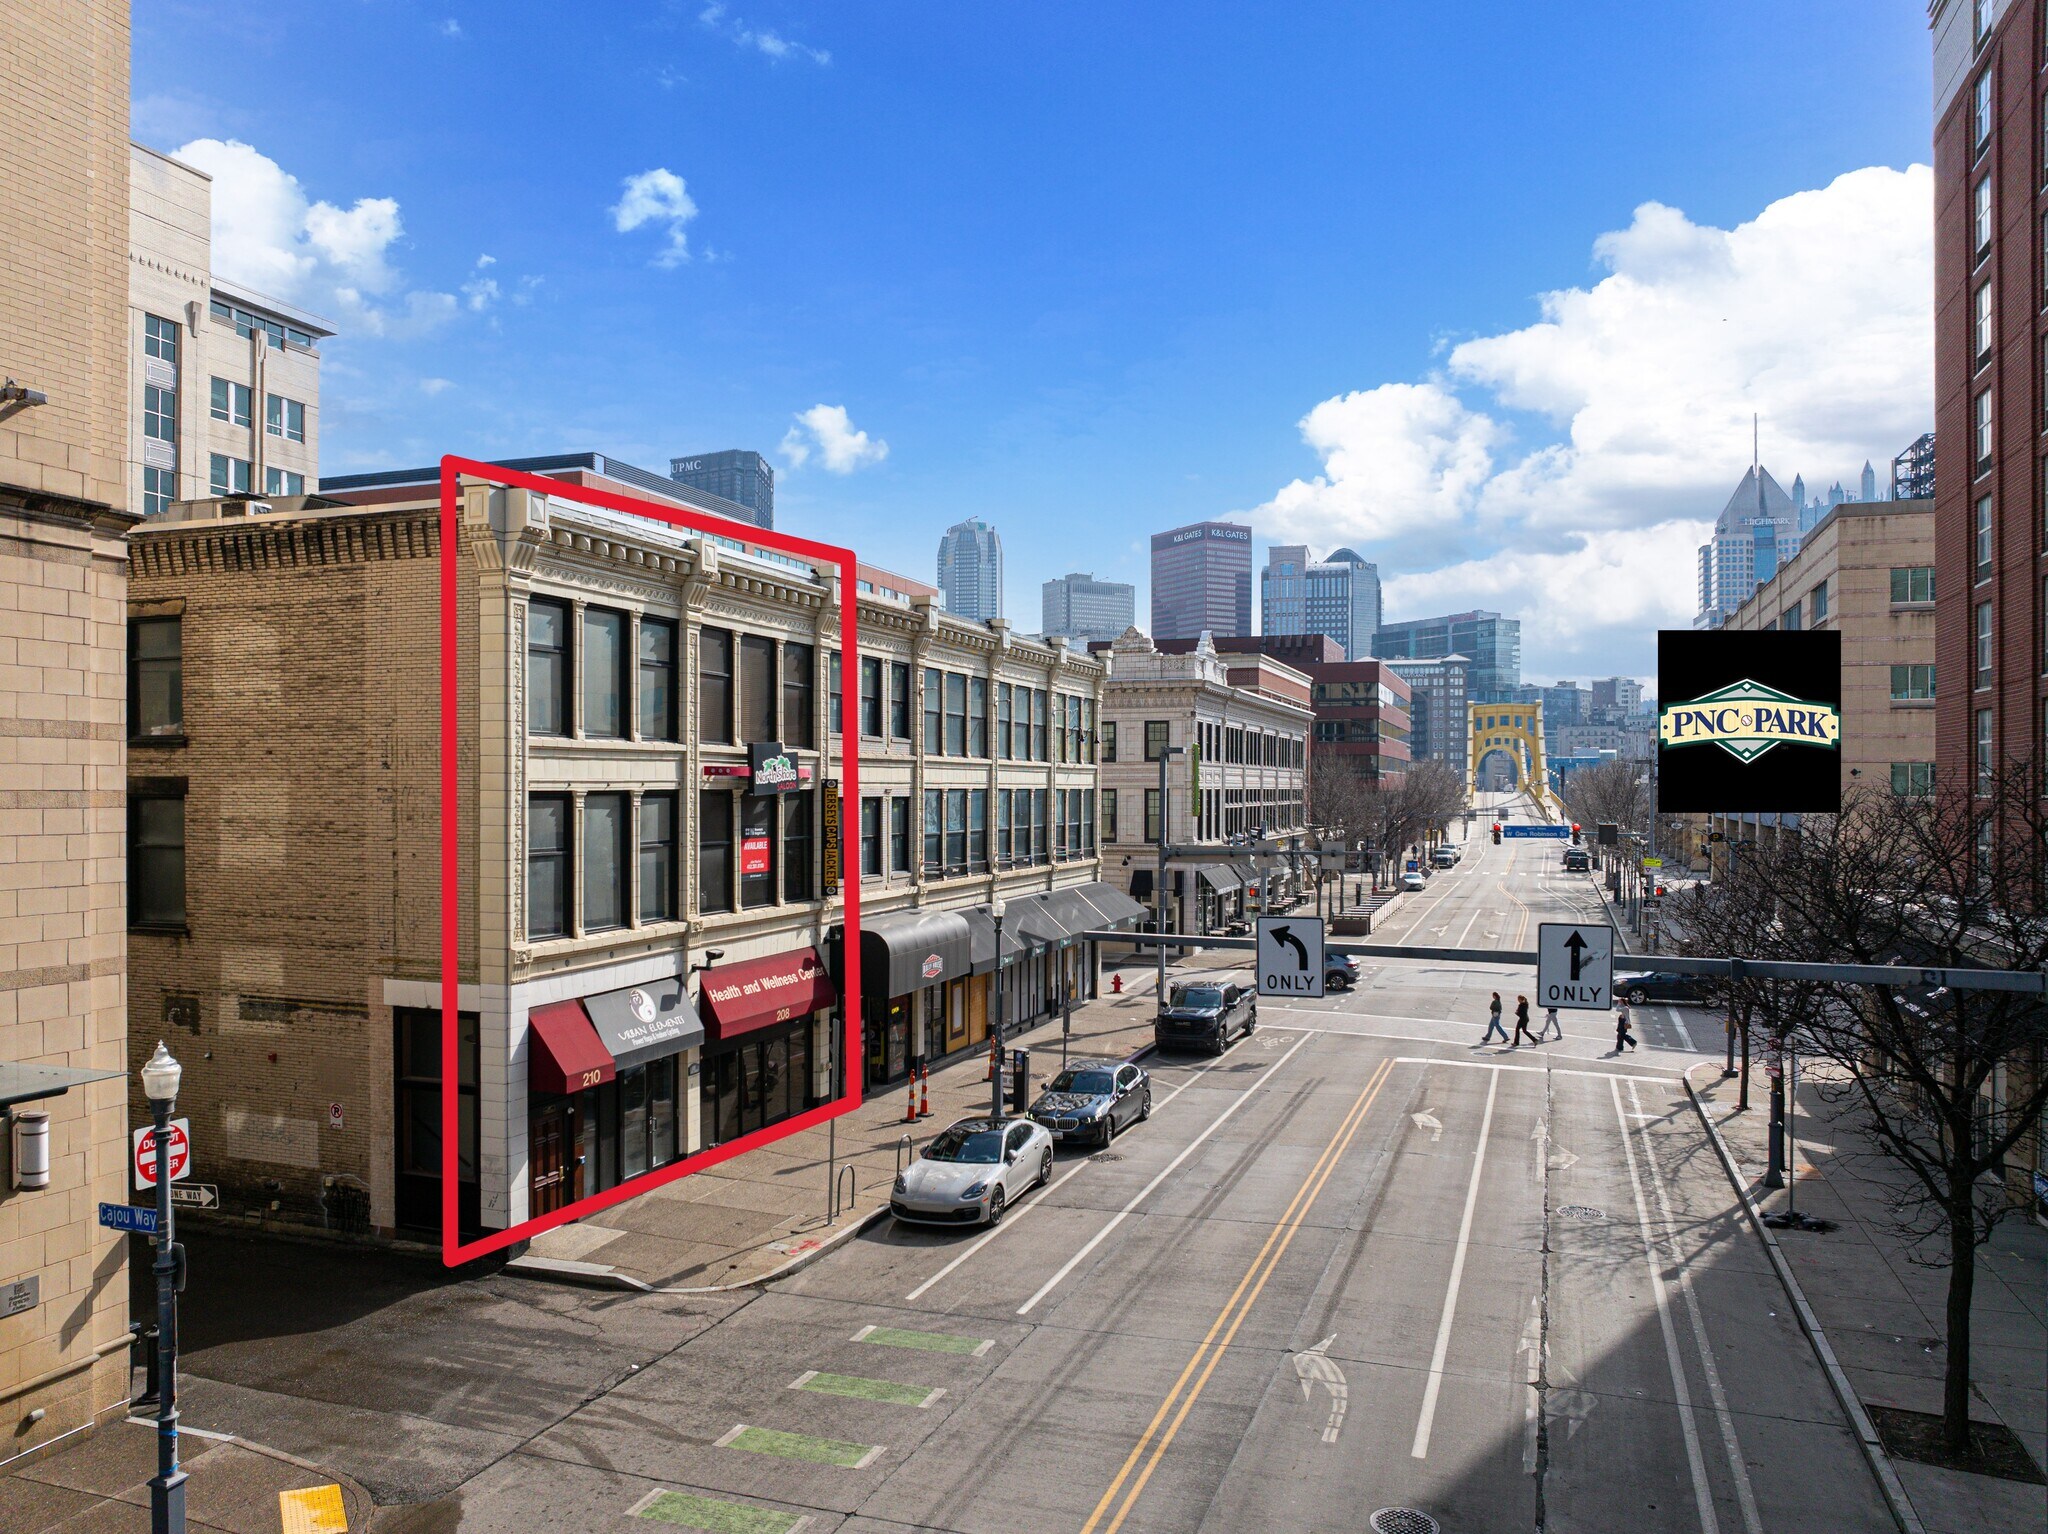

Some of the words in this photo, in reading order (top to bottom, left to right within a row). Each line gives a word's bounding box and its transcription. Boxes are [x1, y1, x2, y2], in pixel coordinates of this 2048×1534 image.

[671, 460, 702, 474] UPMC
[1744, 517, 1791, 526] HIGHMARK
[1184, 529, 1202, 540] GATES
[1211, 528, 1225, 537] K&L
[1225, 530, 1248, 540] GATES
[755, 767, 777, 785] North
[776, 760, 797, 781] Shore
[776, 781, 797, 792] SALOON
[826, 789, 837, 825] JERSEYS
[744, 842, 767, 850] AVAILABLE
[826, 826, 837, 849] CAPS
[826, 850, 837, 886] JACKETS
[709, 985, 742, 1003] Health
[743, 979, 761, 995] and
[760, 973, 798, 990] Wellness
[797, 965, 825, 980] Center
[1266, 974, 1316, 991] ONLY
[1548, 984, 1604, 1003] ONLY
[777, 1008, 790, 1022] 208
[618, 1025, 648, 1041] URBAN
[648, 1015, 685, 1032] ELEMENTS
[582, 1069, 601, 1087] 210
[186, 1191, 201, 1200] WAY
[100, 1205, 130, 1225] Cajou
[135, 1209, 157, 1230] Way
